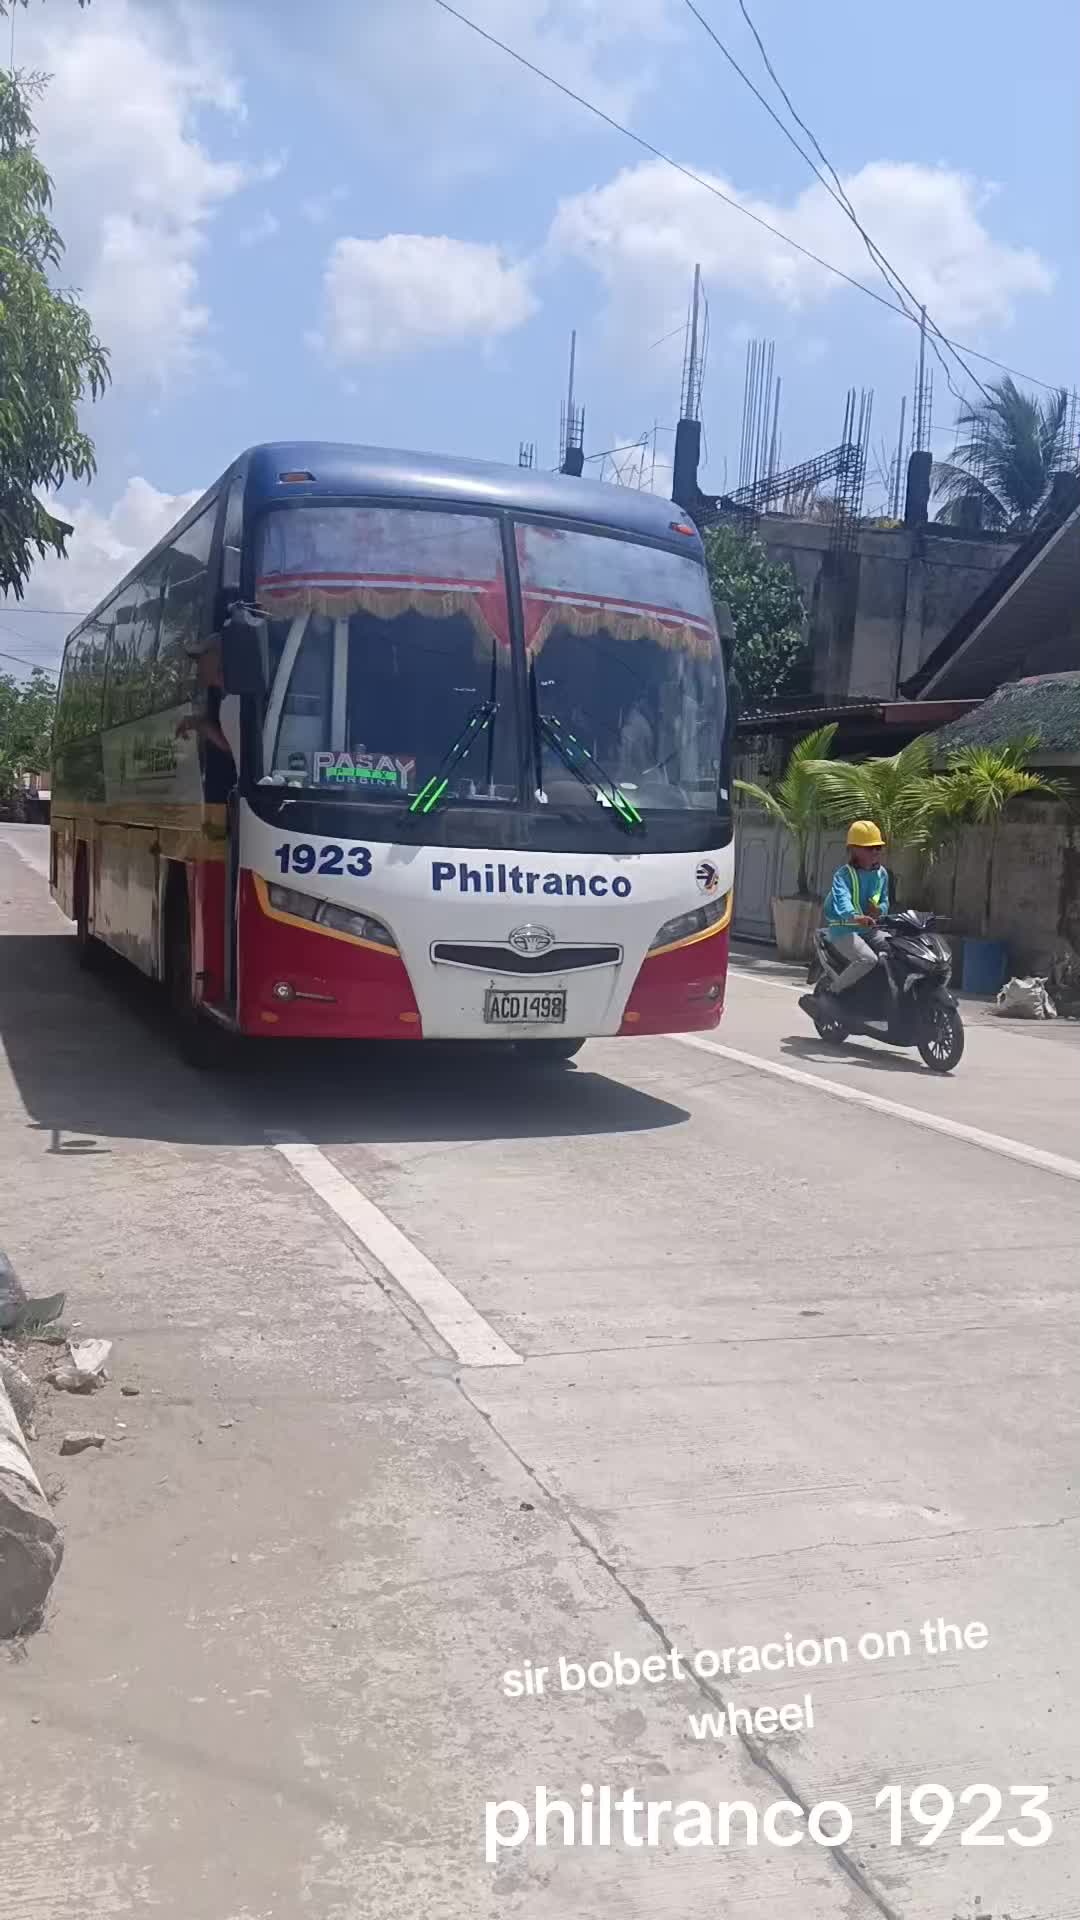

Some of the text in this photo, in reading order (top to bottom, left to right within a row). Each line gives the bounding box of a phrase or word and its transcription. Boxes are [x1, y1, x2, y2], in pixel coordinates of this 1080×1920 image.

[313, 751, 416, 790] PASAY
[274, 843, 373, 877] 1923
[431, 861, 632, 898] Philtranco
